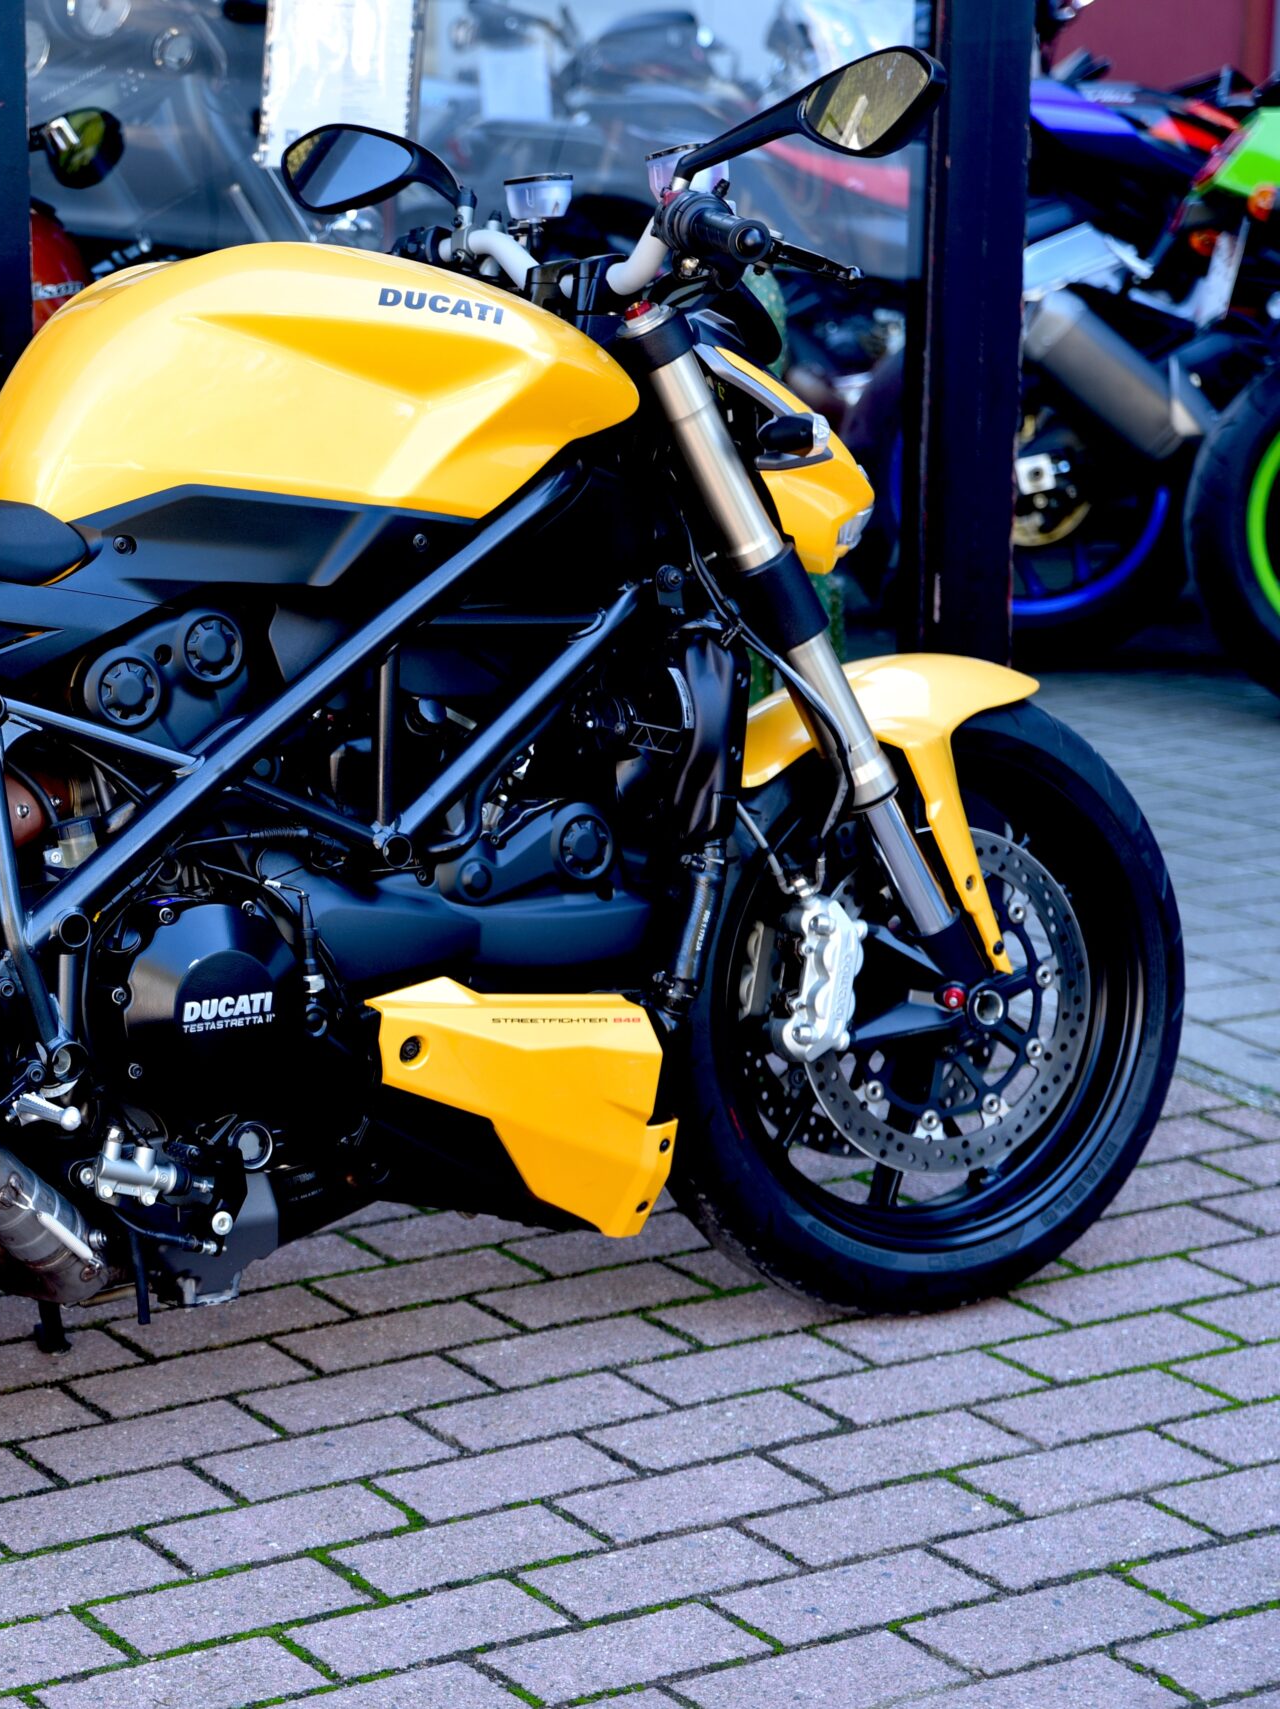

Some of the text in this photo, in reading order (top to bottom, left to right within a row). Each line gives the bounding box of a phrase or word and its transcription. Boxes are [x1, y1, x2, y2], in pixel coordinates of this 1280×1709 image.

[378, 287, 504, 325] DUCATI
[183, 991, 273, 1023] DUCATI
[182, 1015, 264, 1034] TESTASTRETTA
